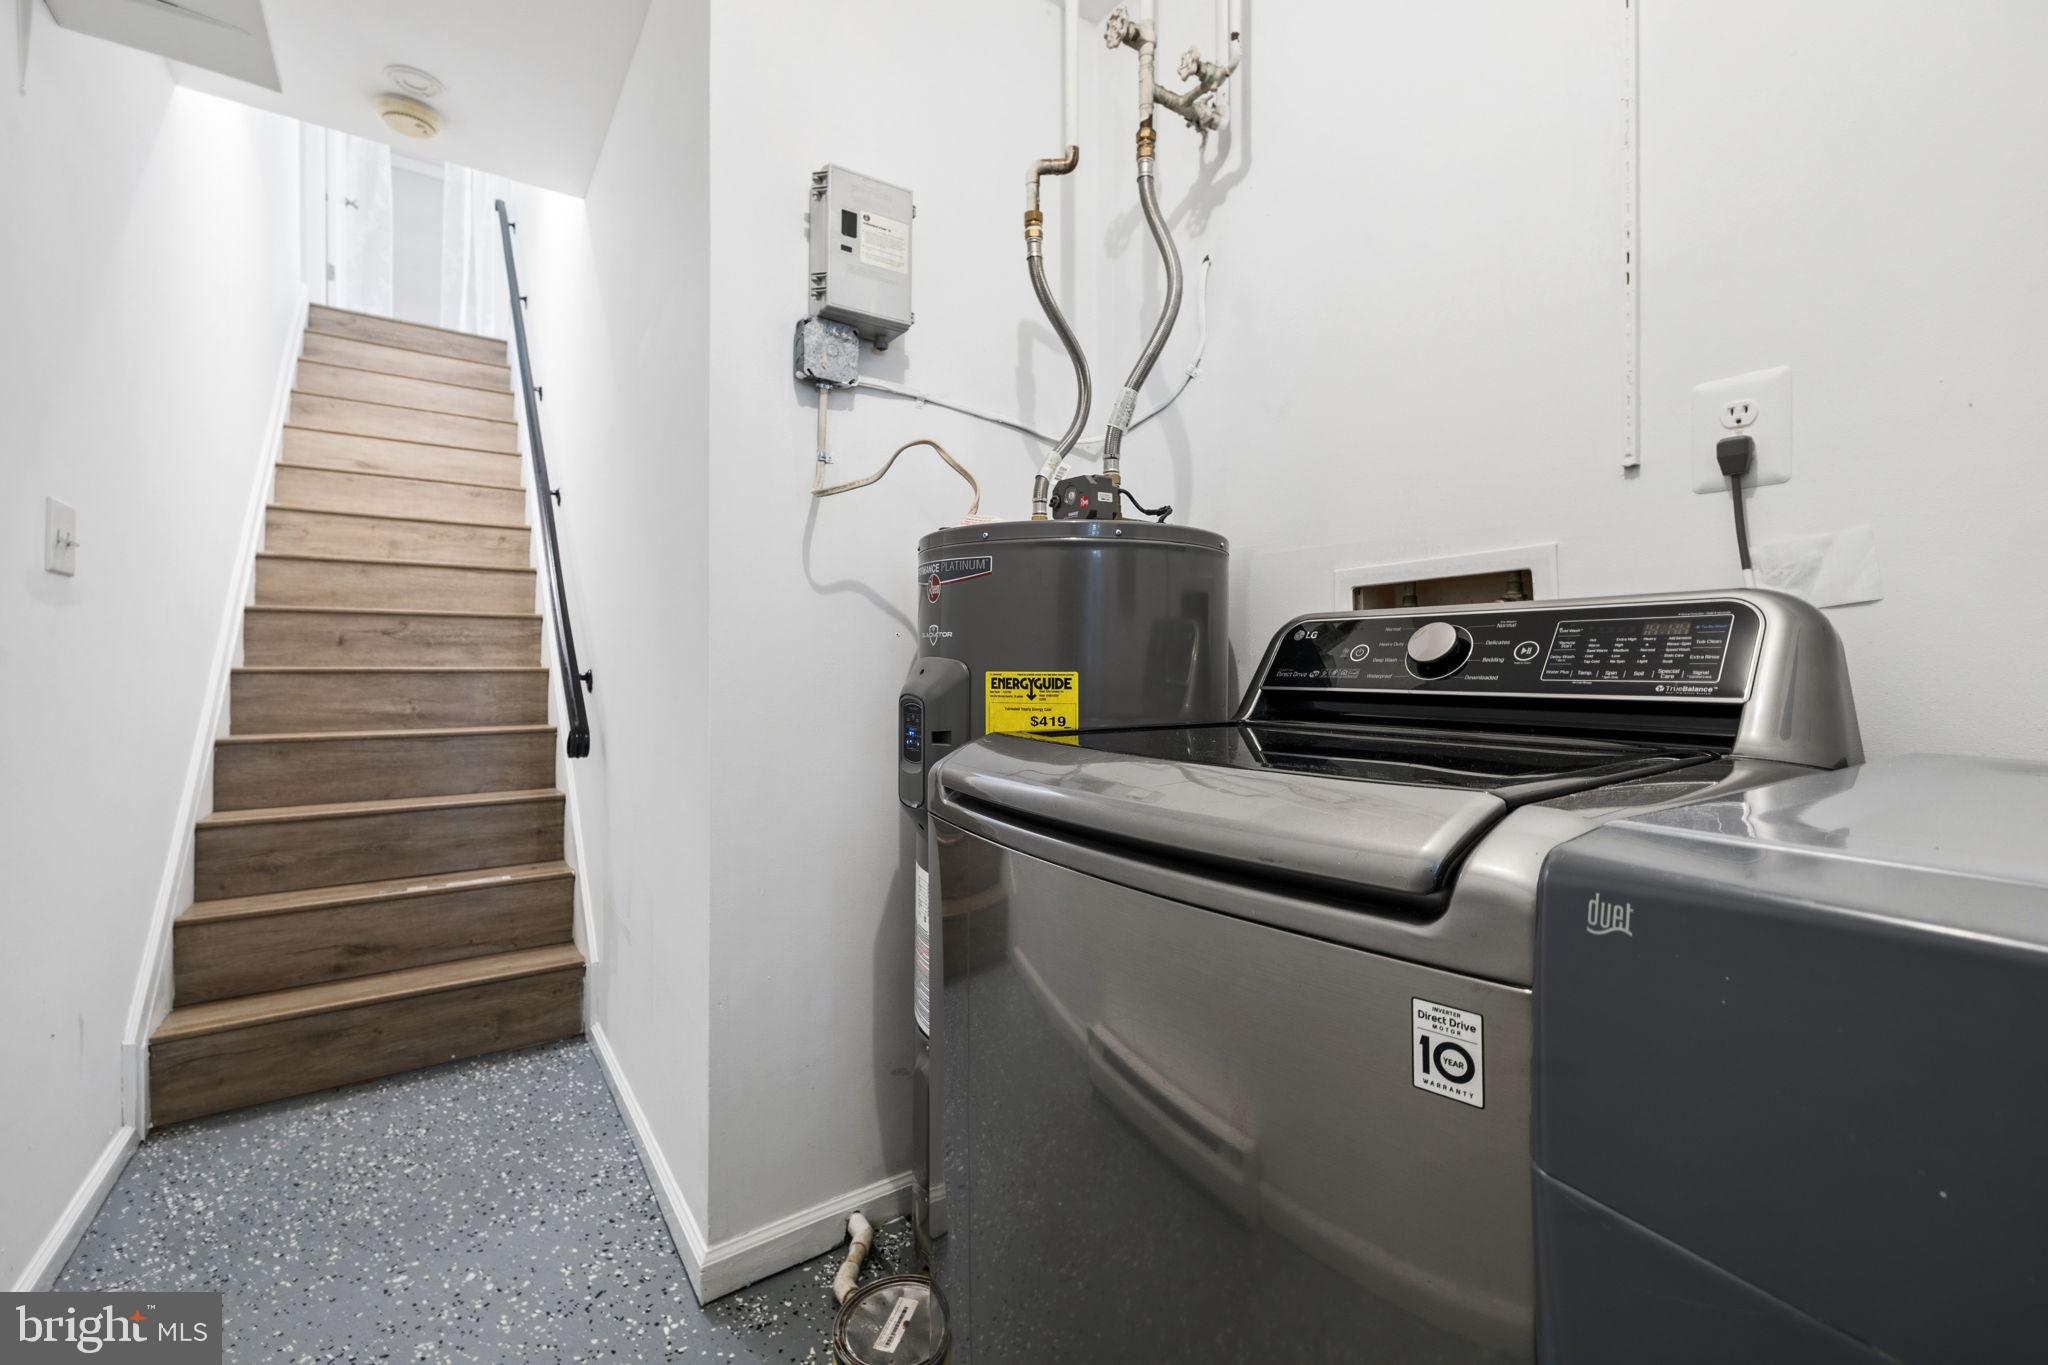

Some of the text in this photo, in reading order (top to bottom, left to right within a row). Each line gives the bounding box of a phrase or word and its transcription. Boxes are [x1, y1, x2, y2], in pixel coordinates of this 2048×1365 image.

[991, 677, 1072, 690] ENERGYGUIDE
[1030, 716, 1066, 727] $419
[1586, 892, 1634, 936] duet
[1432, 1007, 1461, 1018] INVERTER
[1418, 1009, 1477, 1033] Direct Drive
[1432, 1024, 1461, 1035] MOTOR
[1419, 1034, 1475, 1084] 10
[1443, 1057, 1464, 1069] YEAR
[1423, 1078, 1474, 1099] WARRANTY
